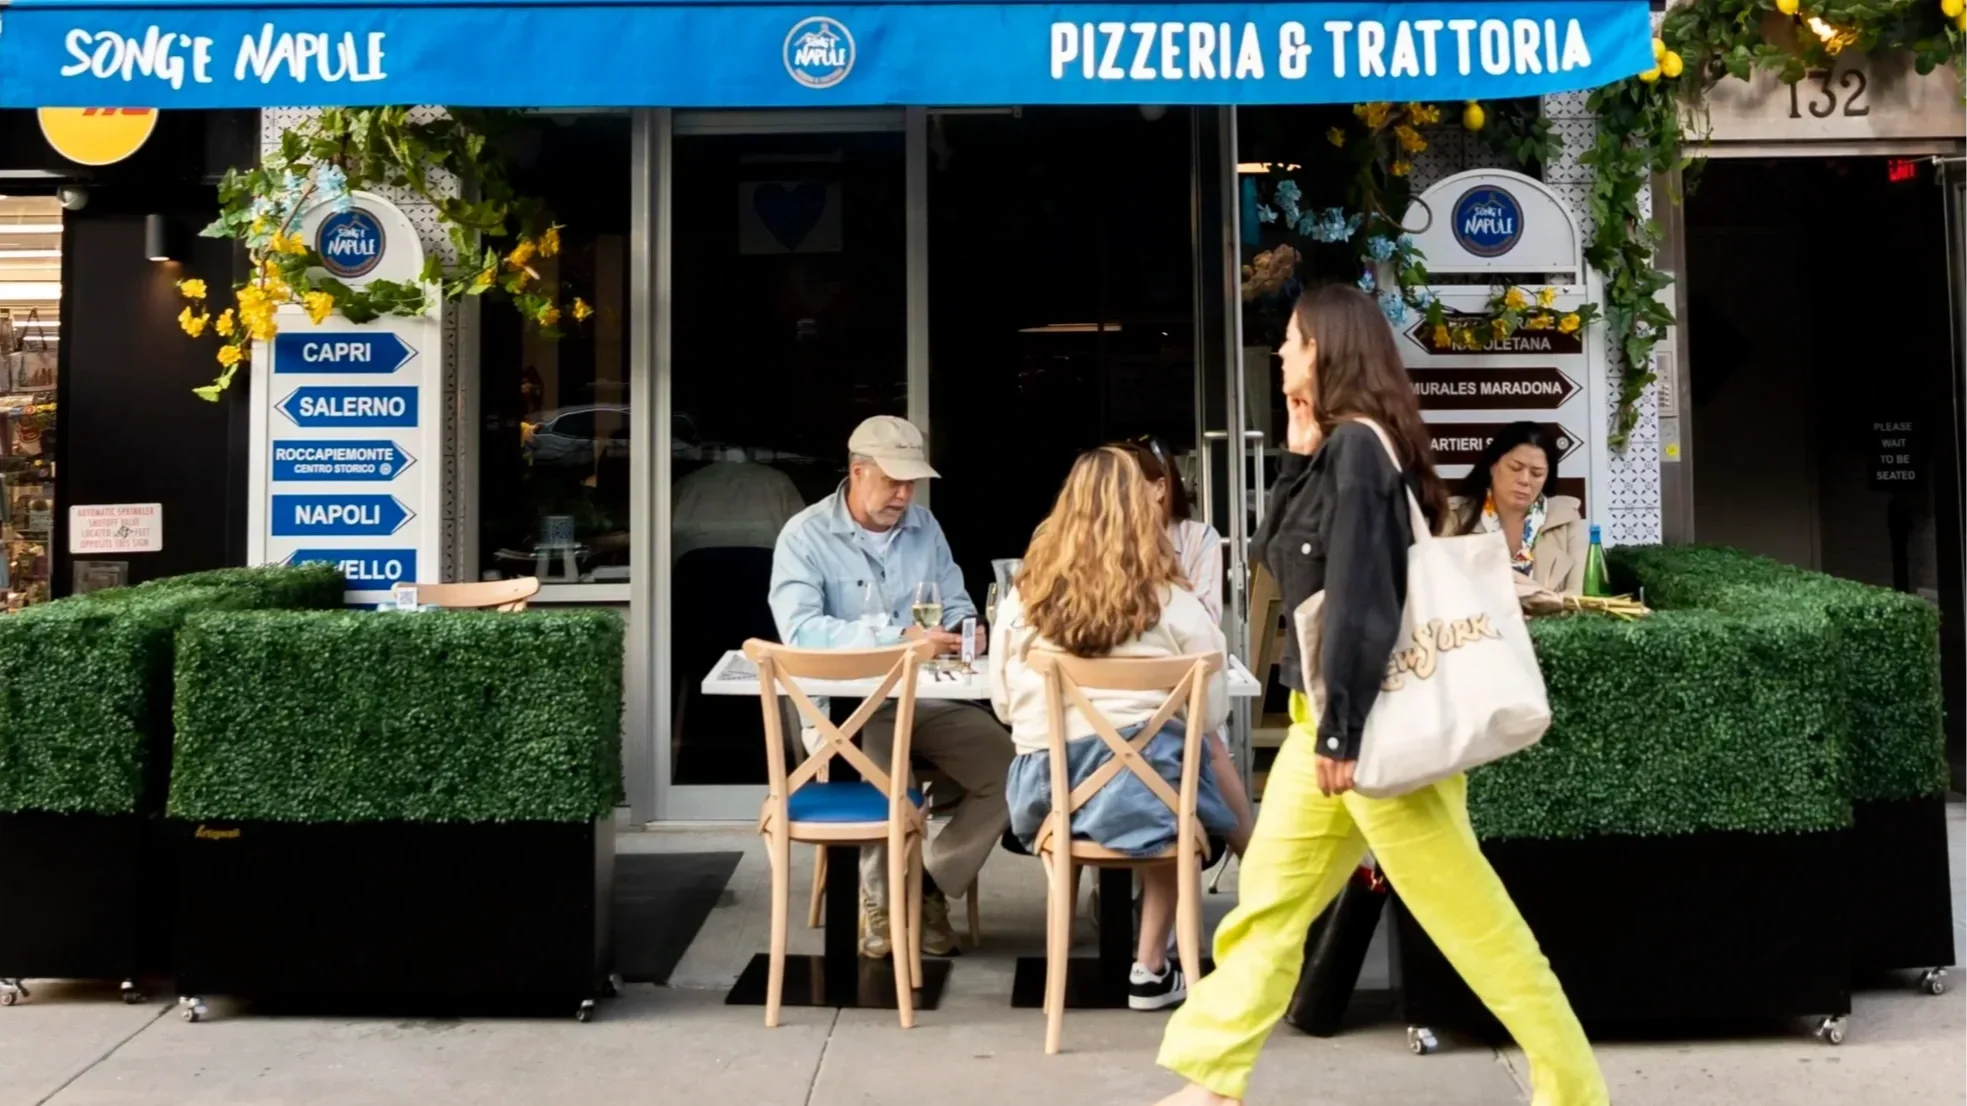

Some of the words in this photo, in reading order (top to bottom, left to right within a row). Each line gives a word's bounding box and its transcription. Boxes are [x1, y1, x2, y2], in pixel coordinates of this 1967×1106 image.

[234, 23, 387, 84] NAPULE
[795, 45, 846, 66] NAPULE
[1050, 21, 1265, 80] PIZZERIA
[1278, 20, 1312, 79] &
[1324, 18, 1592, 79] TRATTORIA
[1789, 68, 1870, 118] 132
[1465, 215, 1513, 235] NAPULE
[328, 236, 376, 255] NAPULE
[303, 342, 371, 362] CAPRI
[1410, 382, 1477, 395] MURALES
[1480, 381, 1563, 395] MARADONA
[299, 396, 406, 417] SALERNO
[1873, 422, 1912, 432] PLEASE
[1430, 438, 1483, 450] ARTIERI
[1881, 438, 1907, 448] WAIT
[276, 448, 394, 461] ROCCAPIEMONTE
[1880, 454, 1893, 464] TO
[1896, 454, 1910, 464] BE
[294, 463, 333, 474] CENTRO
[334, 463, 376, 474] STORICO
[1876, 471, 1915, 481] SEATED
[294, 504, 381, 525] NAPOLI
